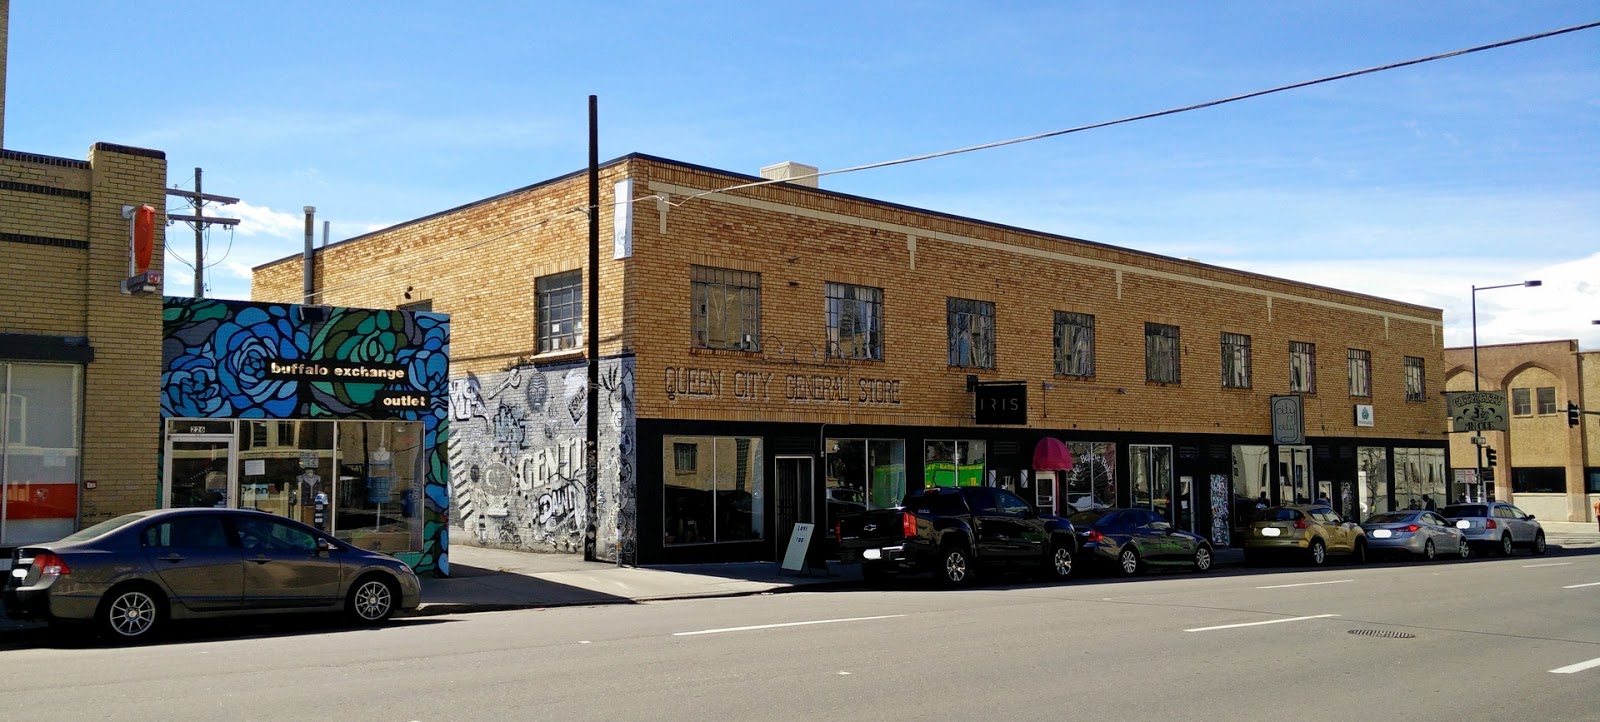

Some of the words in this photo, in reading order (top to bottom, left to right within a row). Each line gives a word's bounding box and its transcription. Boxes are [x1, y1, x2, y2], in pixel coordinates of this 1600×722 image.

[271, 362, 328, 376] buffalo
[334, 366, 405, 380] exchange
[665, 366, 723, 402] QUEEN
[734, 370, 773, 400] CITY
[785, 374, 850, 402] GENERAL
[858, 377, 901, 404] STORE
[383, 395, 426, 407] outlet
[980, 398, 1019, 411] IRIS
